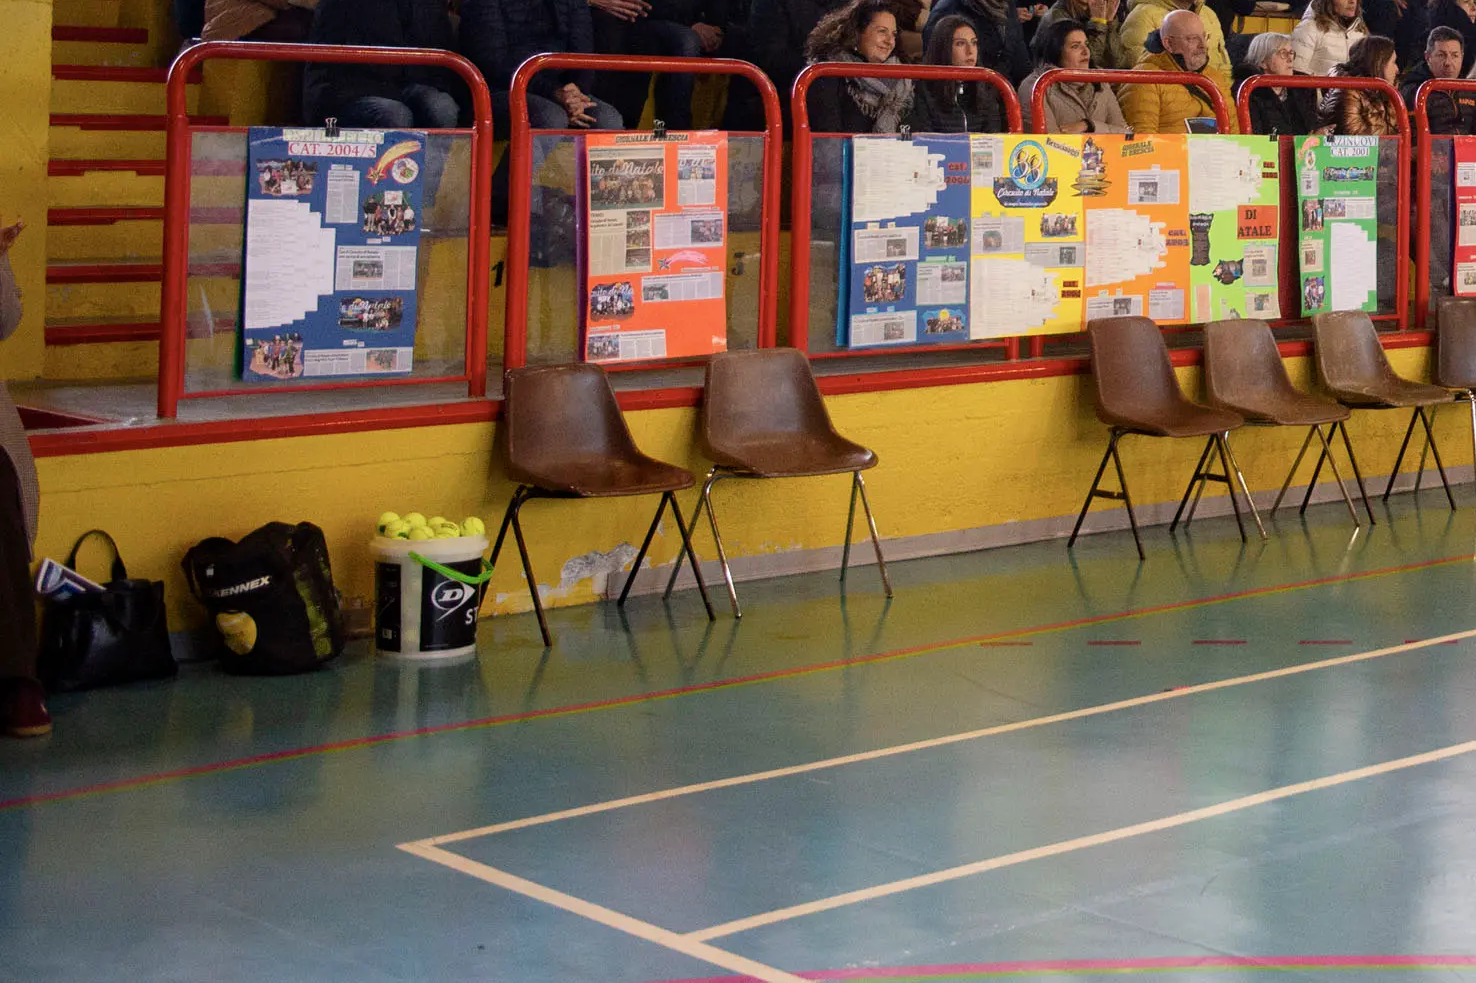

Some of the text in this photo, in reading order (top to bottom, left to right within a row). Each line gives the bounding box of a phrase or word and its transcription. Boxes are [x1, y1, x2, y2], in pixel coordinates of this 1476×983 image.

[288, 143, 376, 158] CAT. 2004/5
[1245, 209, 1257, 220] DI
[1237, 225, 1272, 237] ATALE
